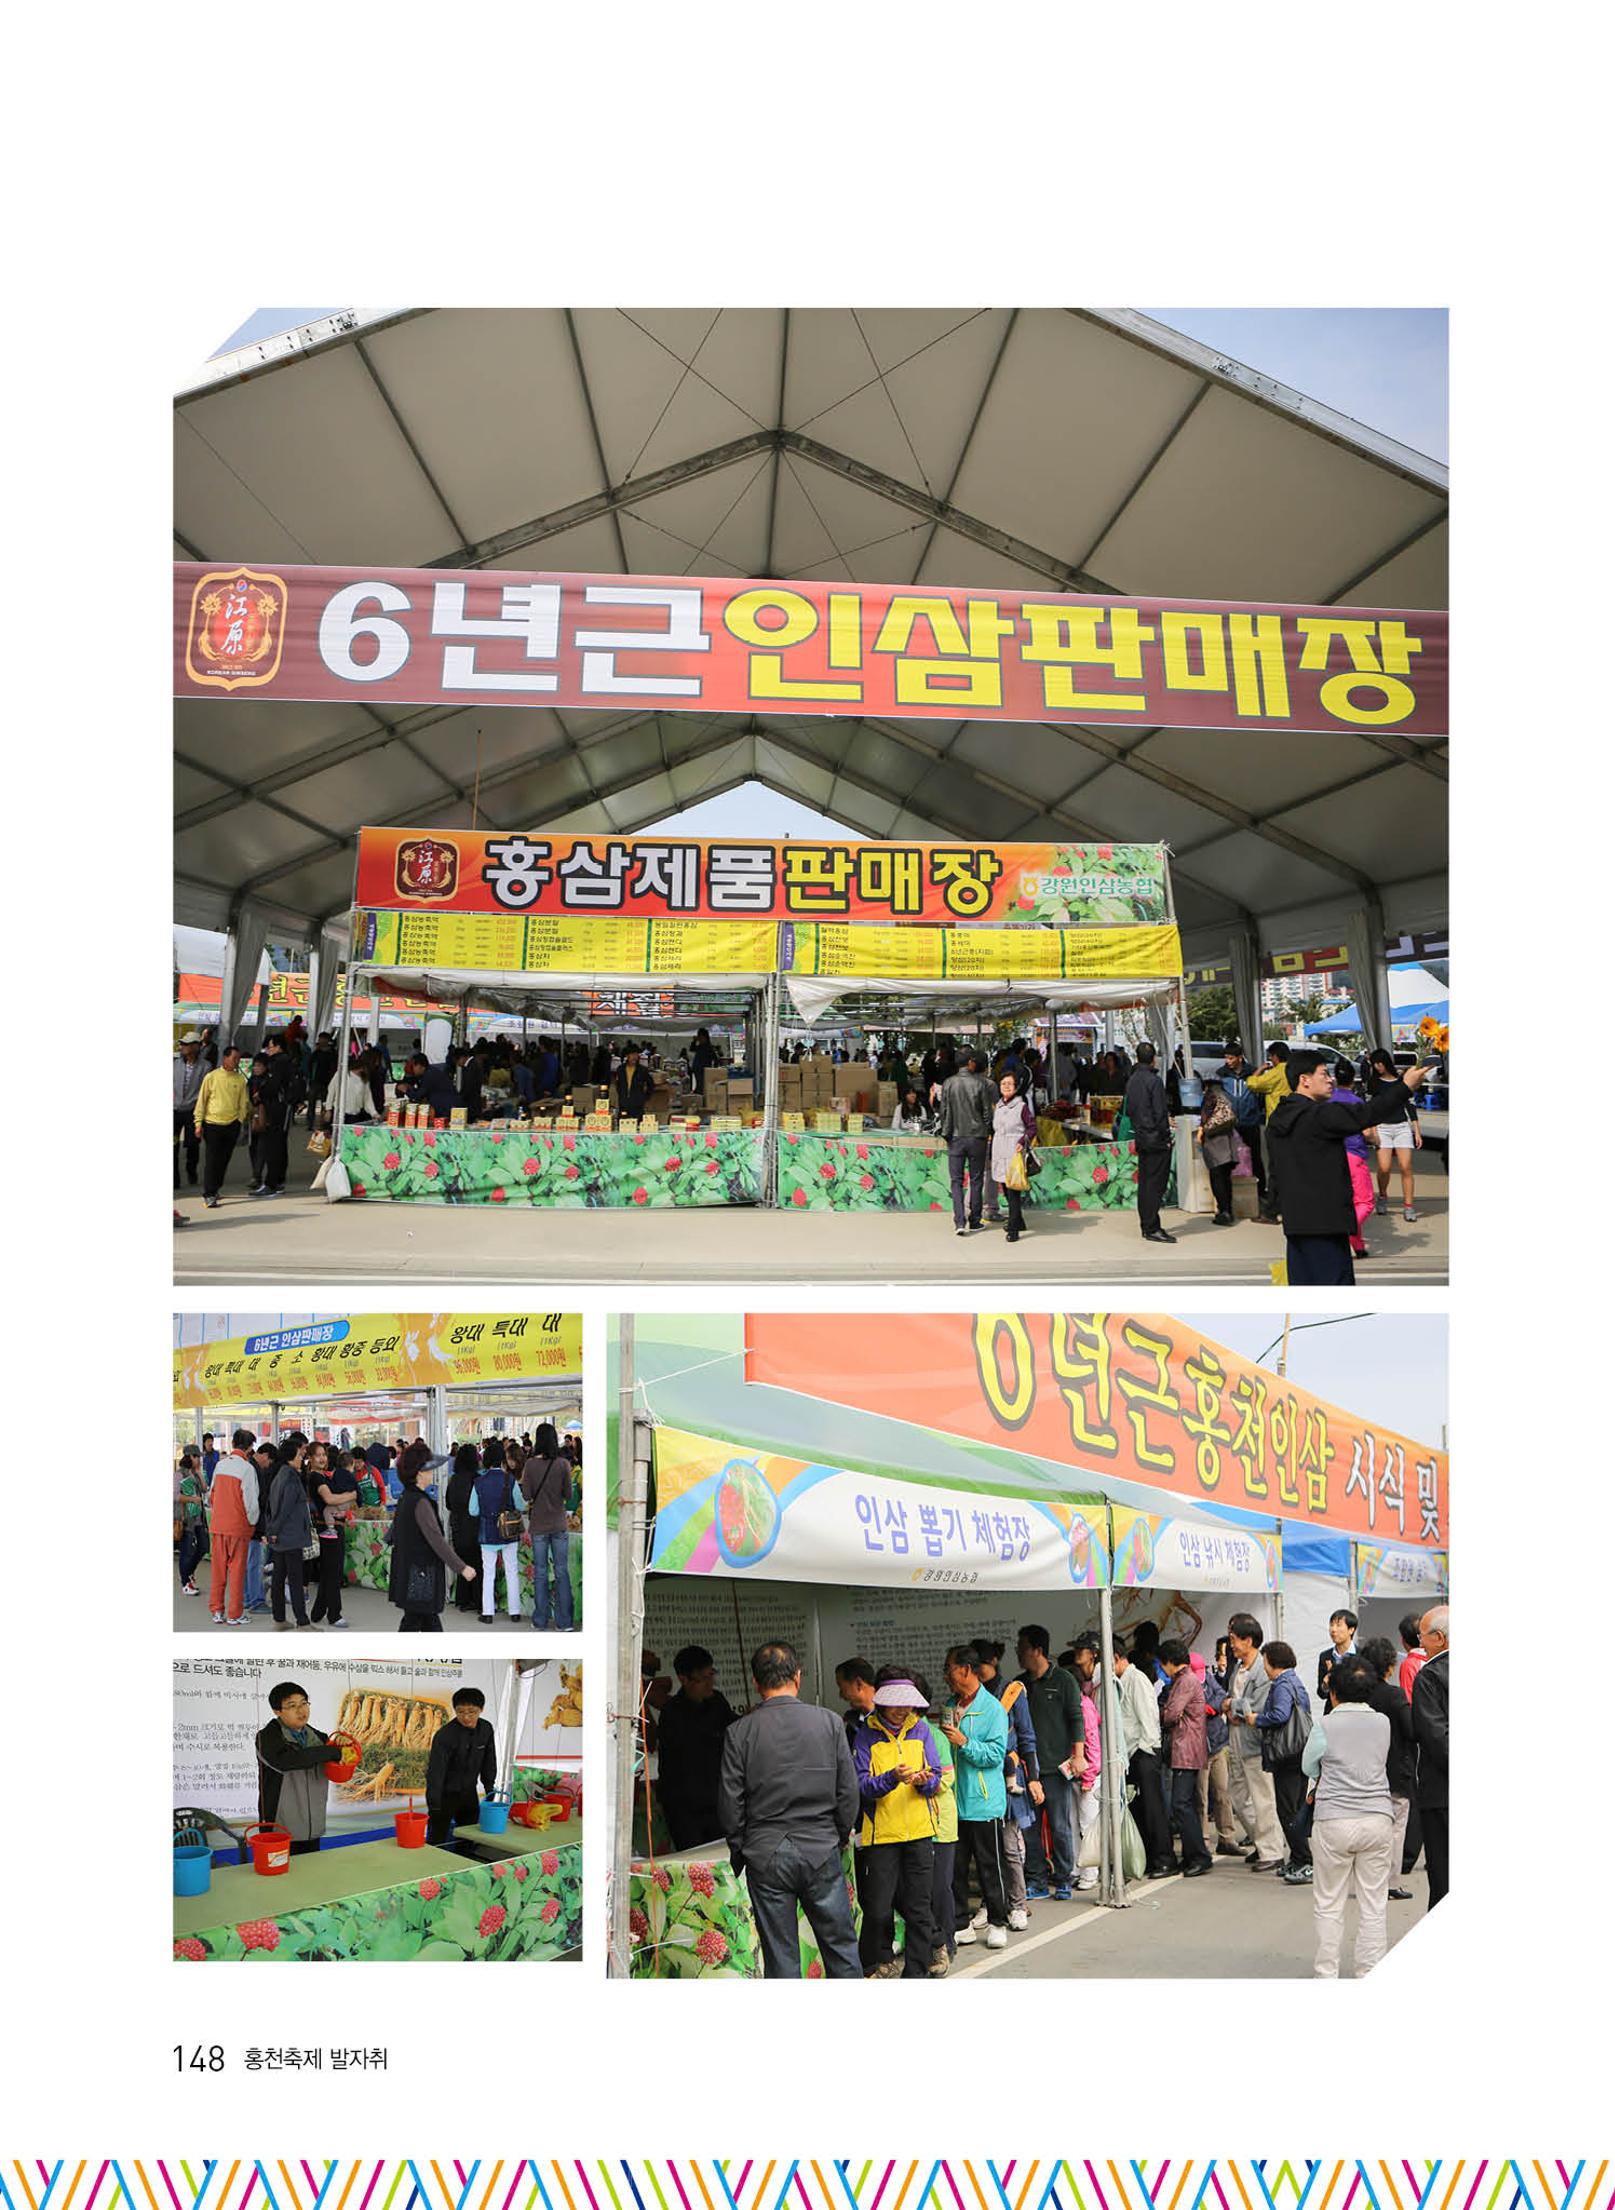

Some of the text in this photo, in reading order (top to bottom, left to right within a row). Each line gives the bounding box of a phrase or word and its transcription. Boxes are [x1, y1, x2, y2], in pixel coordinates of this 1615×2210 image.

[1041, 878, 1153, 895] 강원인삼농협
[492, 1317, 529, 1338] 특대
[542, 1313, 563, 1332] 대
[1345, 1430, 1405, 1536] 시식
[1416, 1457, 1442, 1543] 및
[855, 1494, 1031, 1563] 인삼 뽑기 체험장
[1180, 1531, 1201, 1569] 인삼
[193, 1664, 223, 1676] 드셔도
[225, 1666, 262, 1679] 좋습니다
